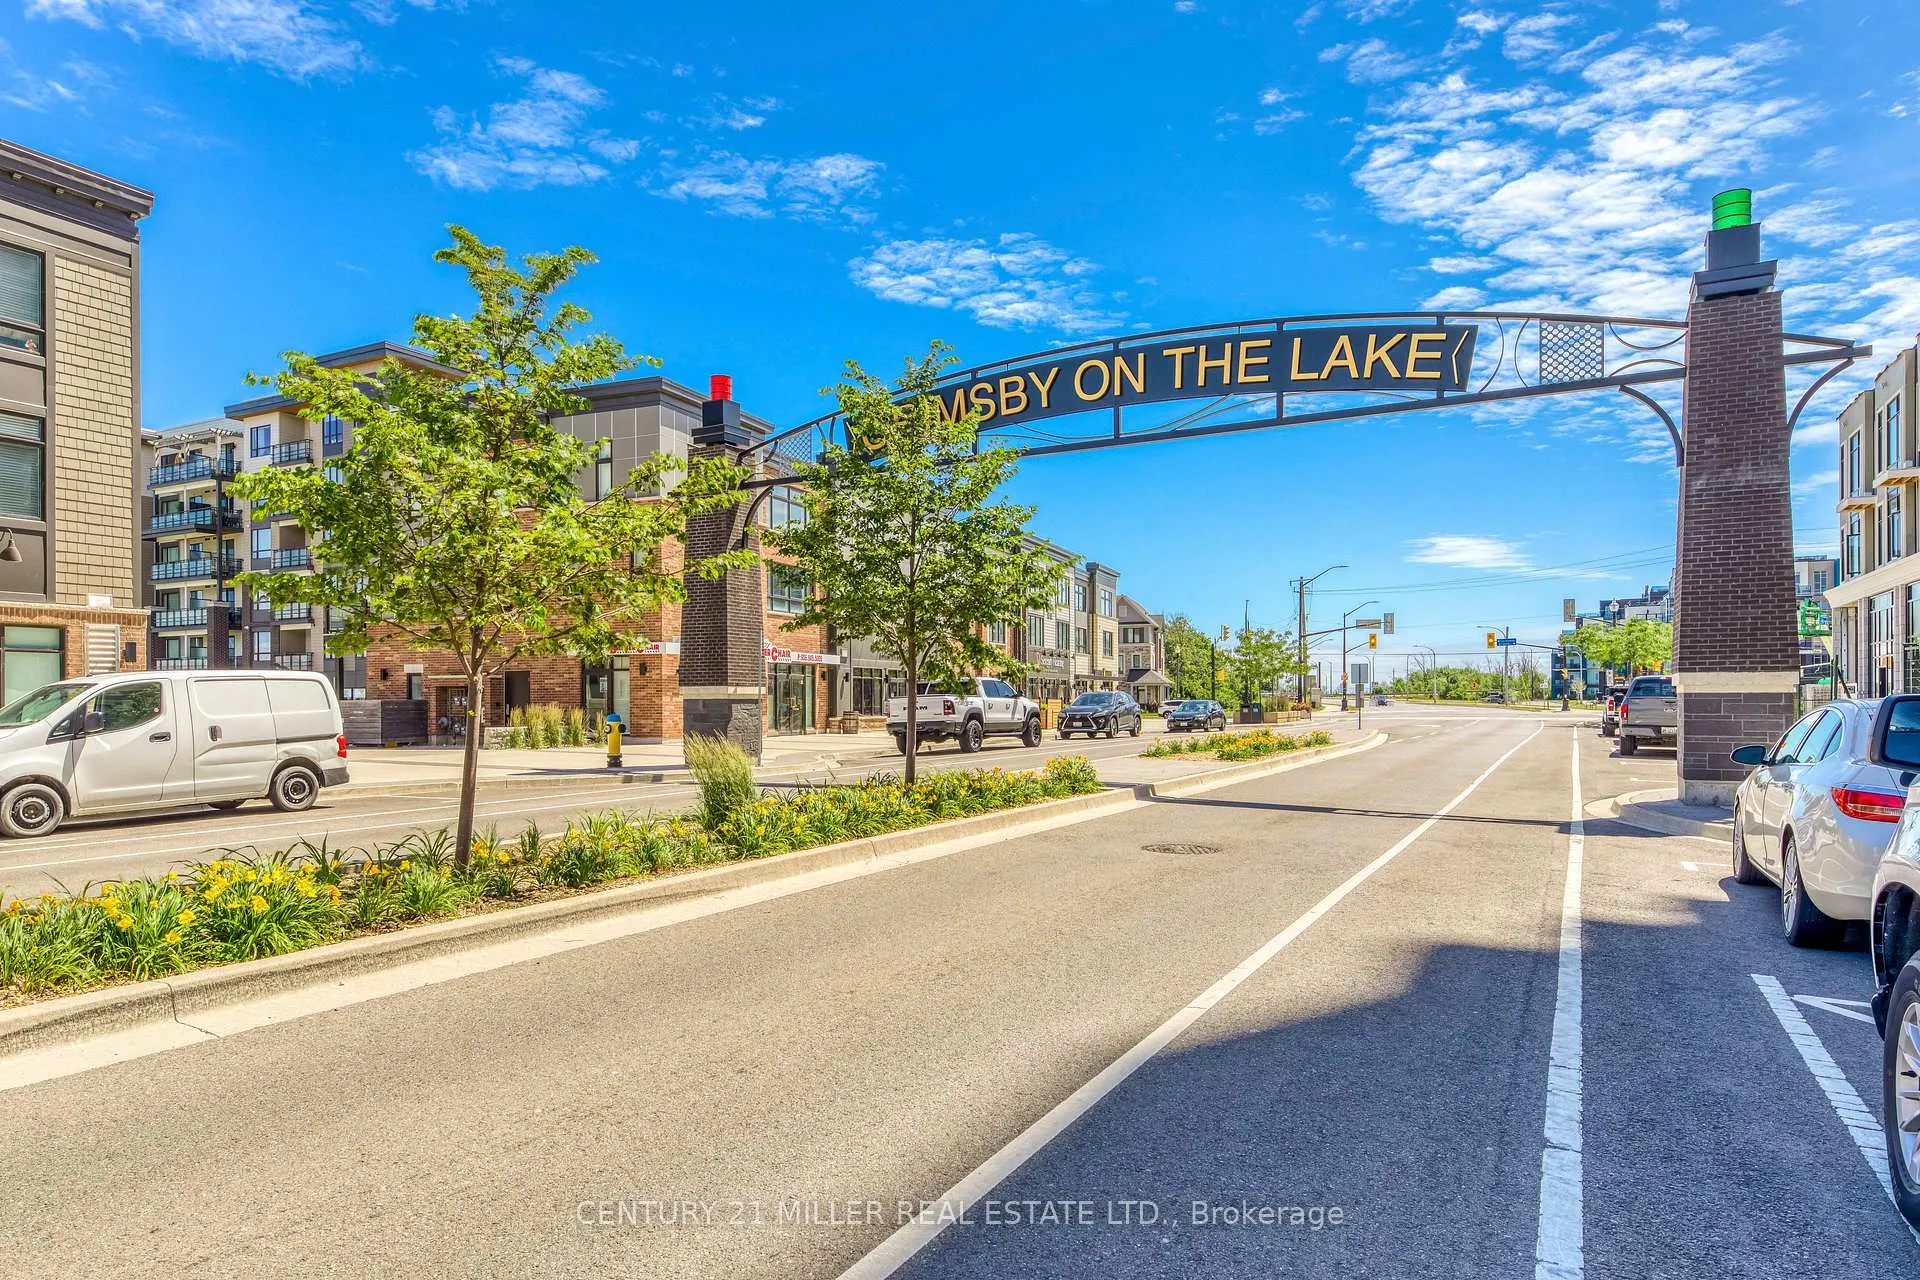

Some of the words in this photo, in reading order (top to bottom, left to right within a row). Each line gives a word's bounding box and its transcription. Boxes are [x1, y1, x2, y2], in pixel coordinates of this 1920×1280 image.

[863, 367, 1060, 450] MSBY
[1074, 352, 1145, 402] ON
[1162, 339, 1272, 390] THE
[1291, 333, 1447, 381] LAKE
